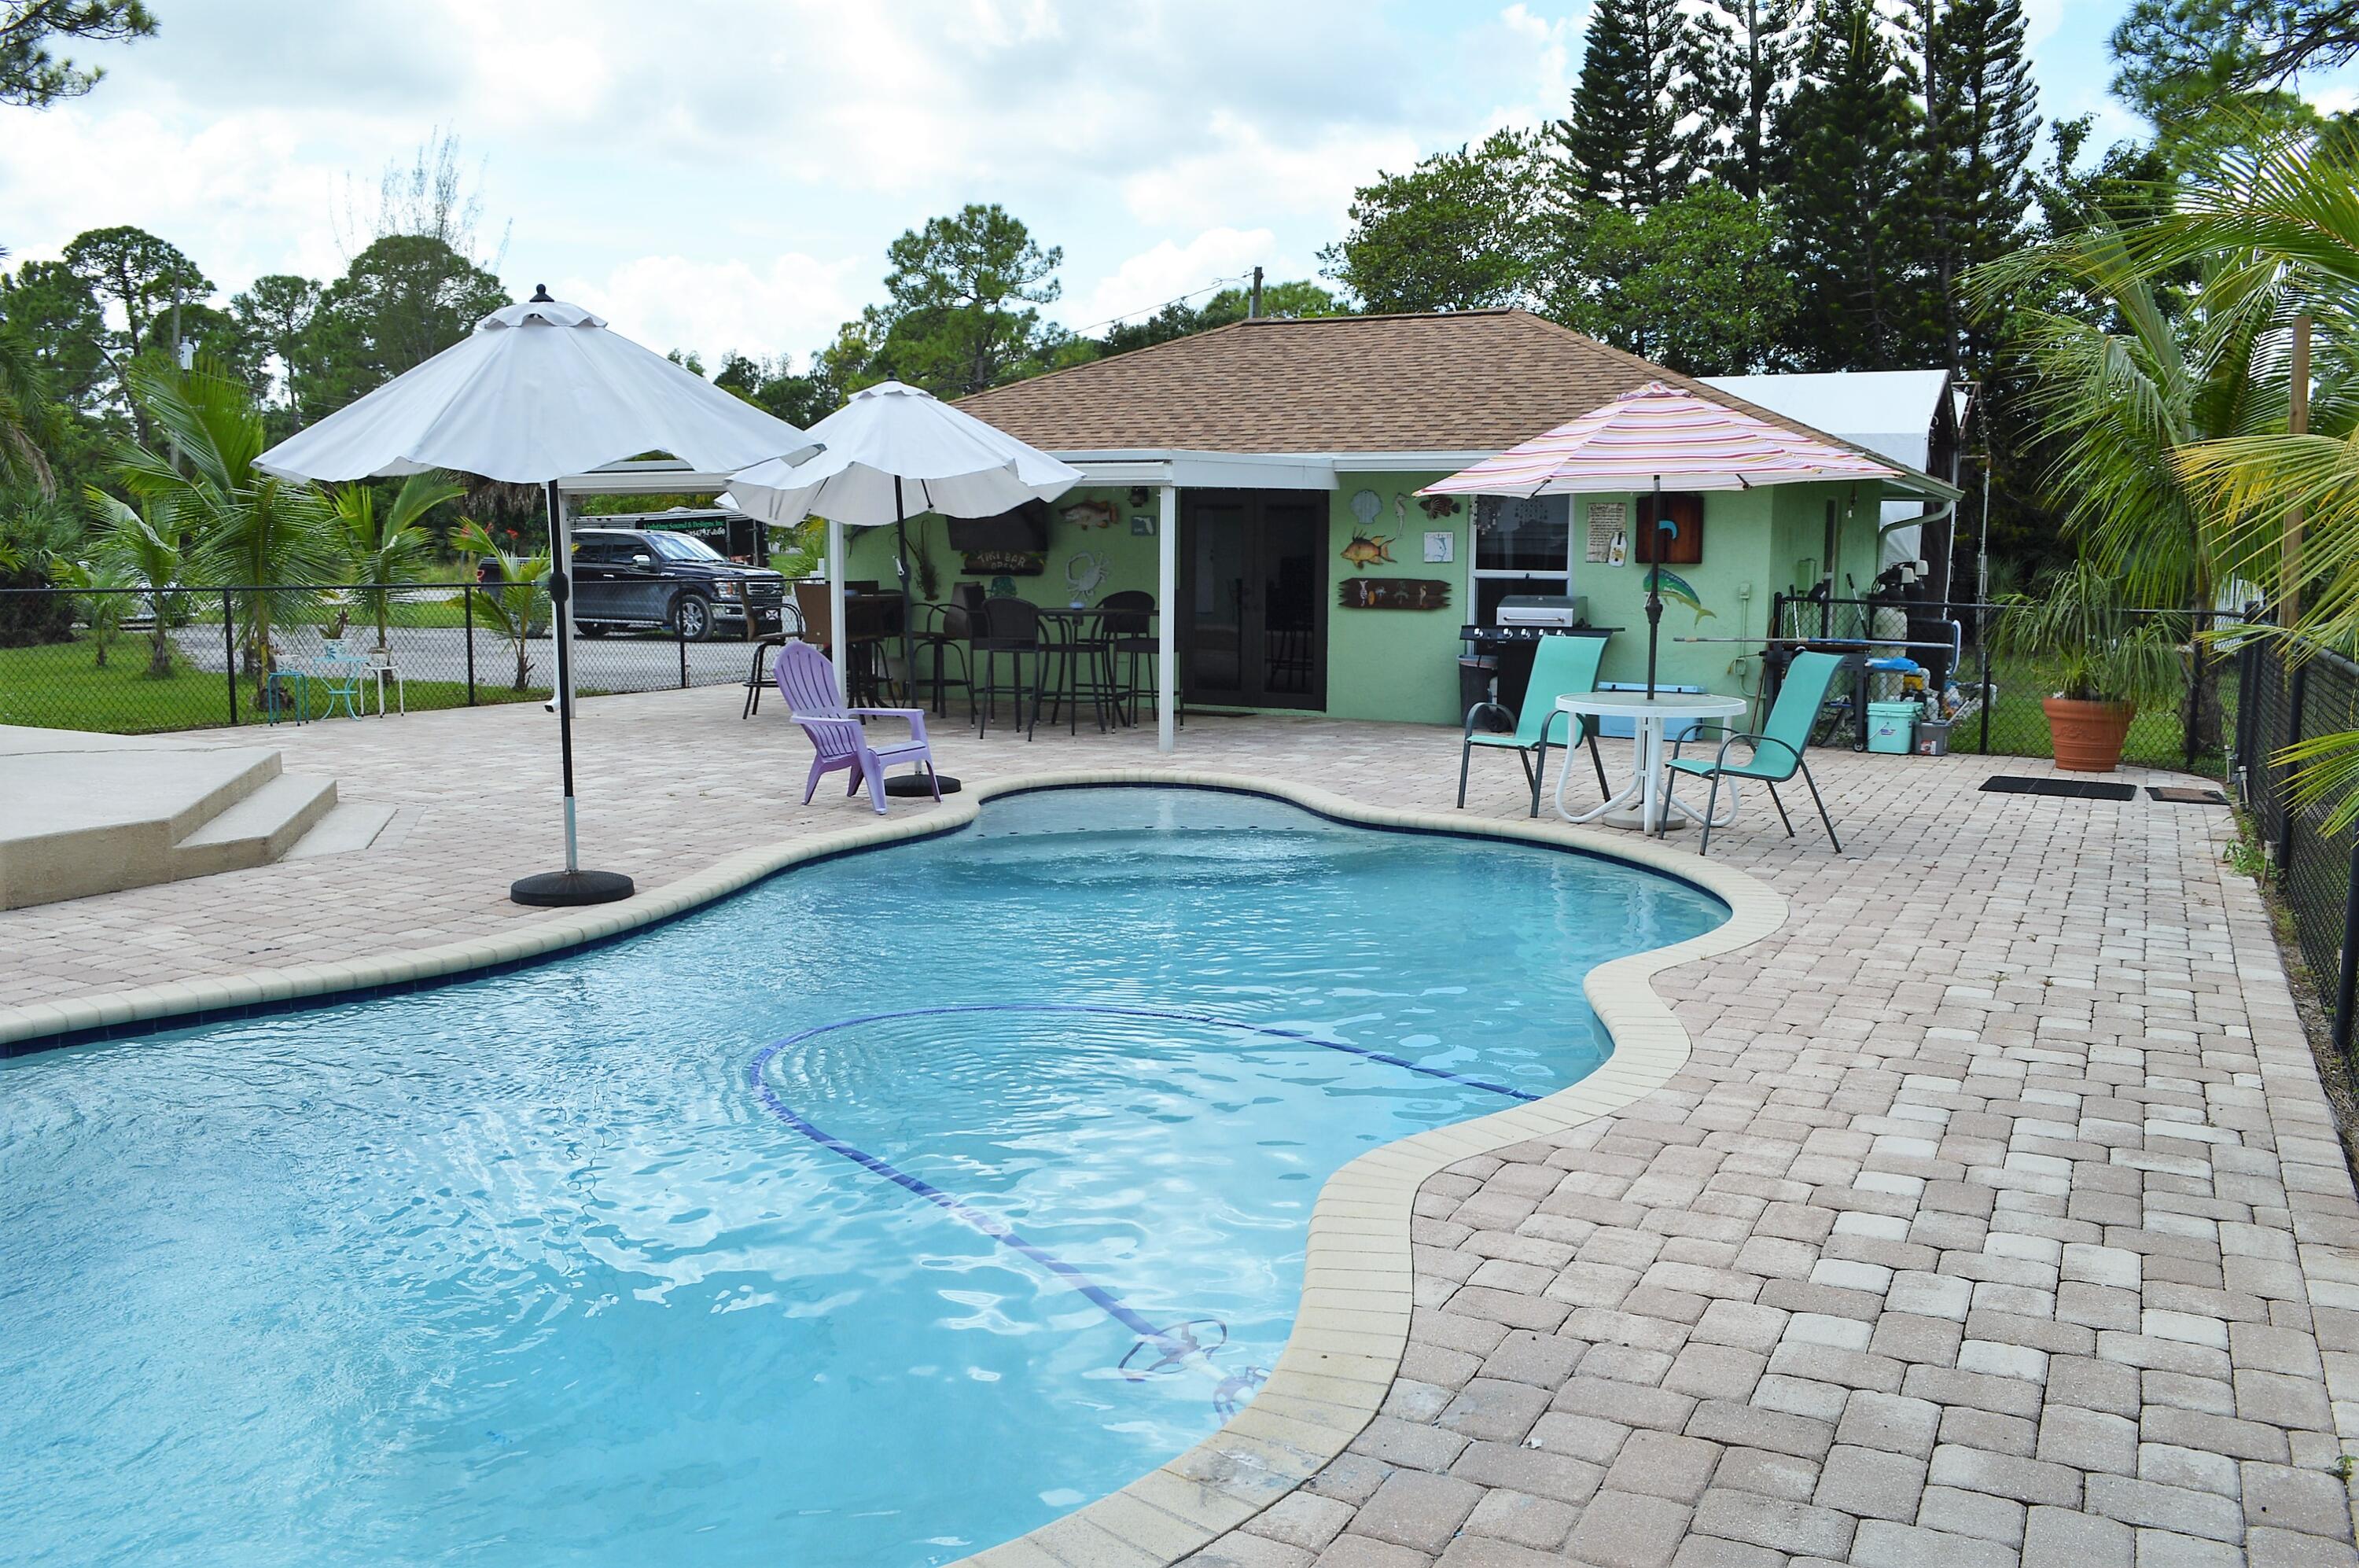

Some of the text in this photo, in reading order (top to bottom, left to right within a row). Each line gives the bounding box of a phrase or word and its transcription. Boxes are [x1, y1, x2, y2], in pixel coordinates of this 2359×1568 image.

[977, 551, 1026, 567] TIKI BAR
[991, 561, 1018, 570] OPEN
